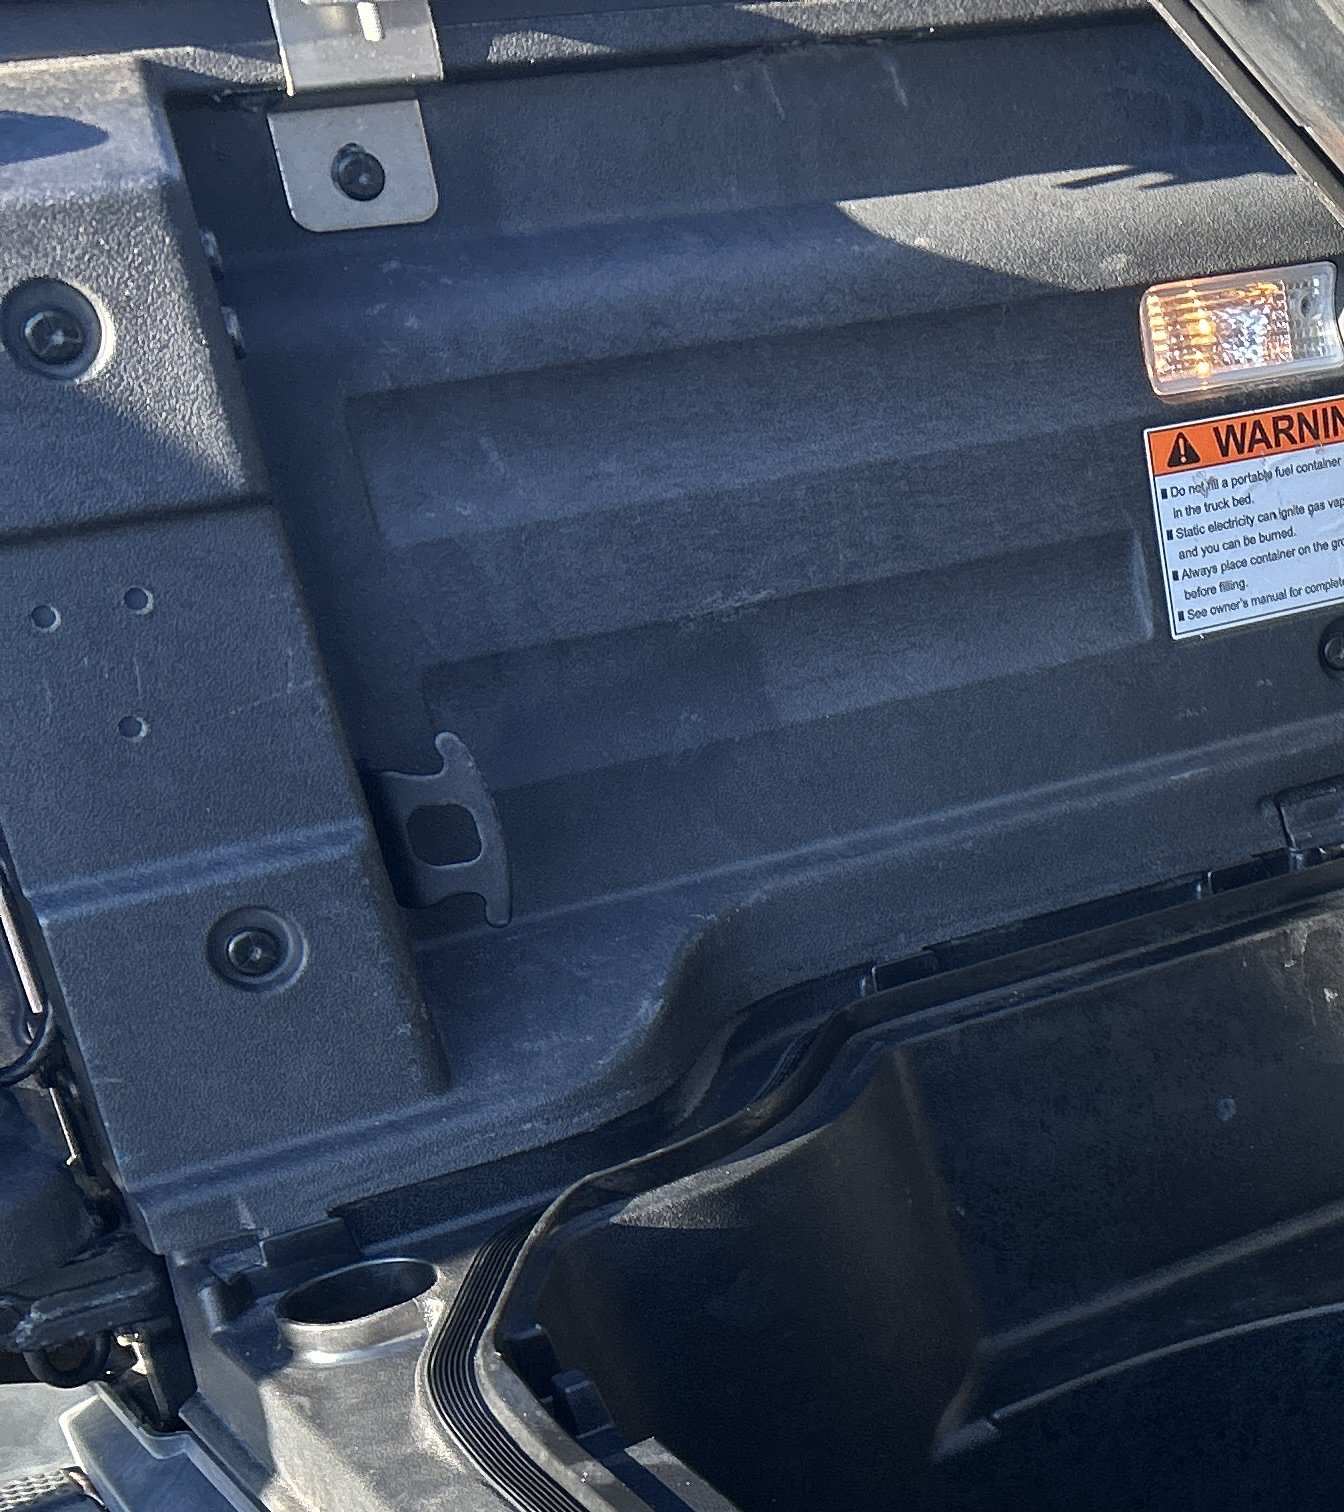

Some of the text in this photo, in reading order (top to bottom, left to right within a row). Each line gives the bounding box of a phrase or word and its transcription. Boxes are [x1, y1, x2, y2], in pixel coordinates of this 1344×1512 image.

[1170, 486, 1186, 499] Do
[1221, 478, 1229, 489] a
[1230, 470, 1273, 490] portable
[1274, 463, 1294, 478] fuel
[1295, 456, 1342, 475] container
[1172, 493, 1255, 519] in the truck bed.
[1175, 523, 1206, 540] Static
[1207, 514, 1256, 533] electricity
[1257, 510, 1278, 524] can
[1278, 504, 1306, 521] ignite
[1307, 501, 1326, 519] gas
[1178, 547, 1199, 560] and
[1200, 543, 1220, 560] you
[1222, 538, 1241, 552] can
[1243, 534, 1257, 547] be
[1181, 563, 1218, 581] Always
[1220, 558, 1248, 575] place
[1249, 547, 1296, 566] container
[1298, 543, 1311, 556] on
[1313, 538, 1329, 552] the
[1184, 584, 1217, 601] before
[1187, 607, 1208, 621] See
[1209, 598, 1249, 617] owner's
[1250, 588, 1288, 607] manual
[1289, 586, 1303, 599] for
